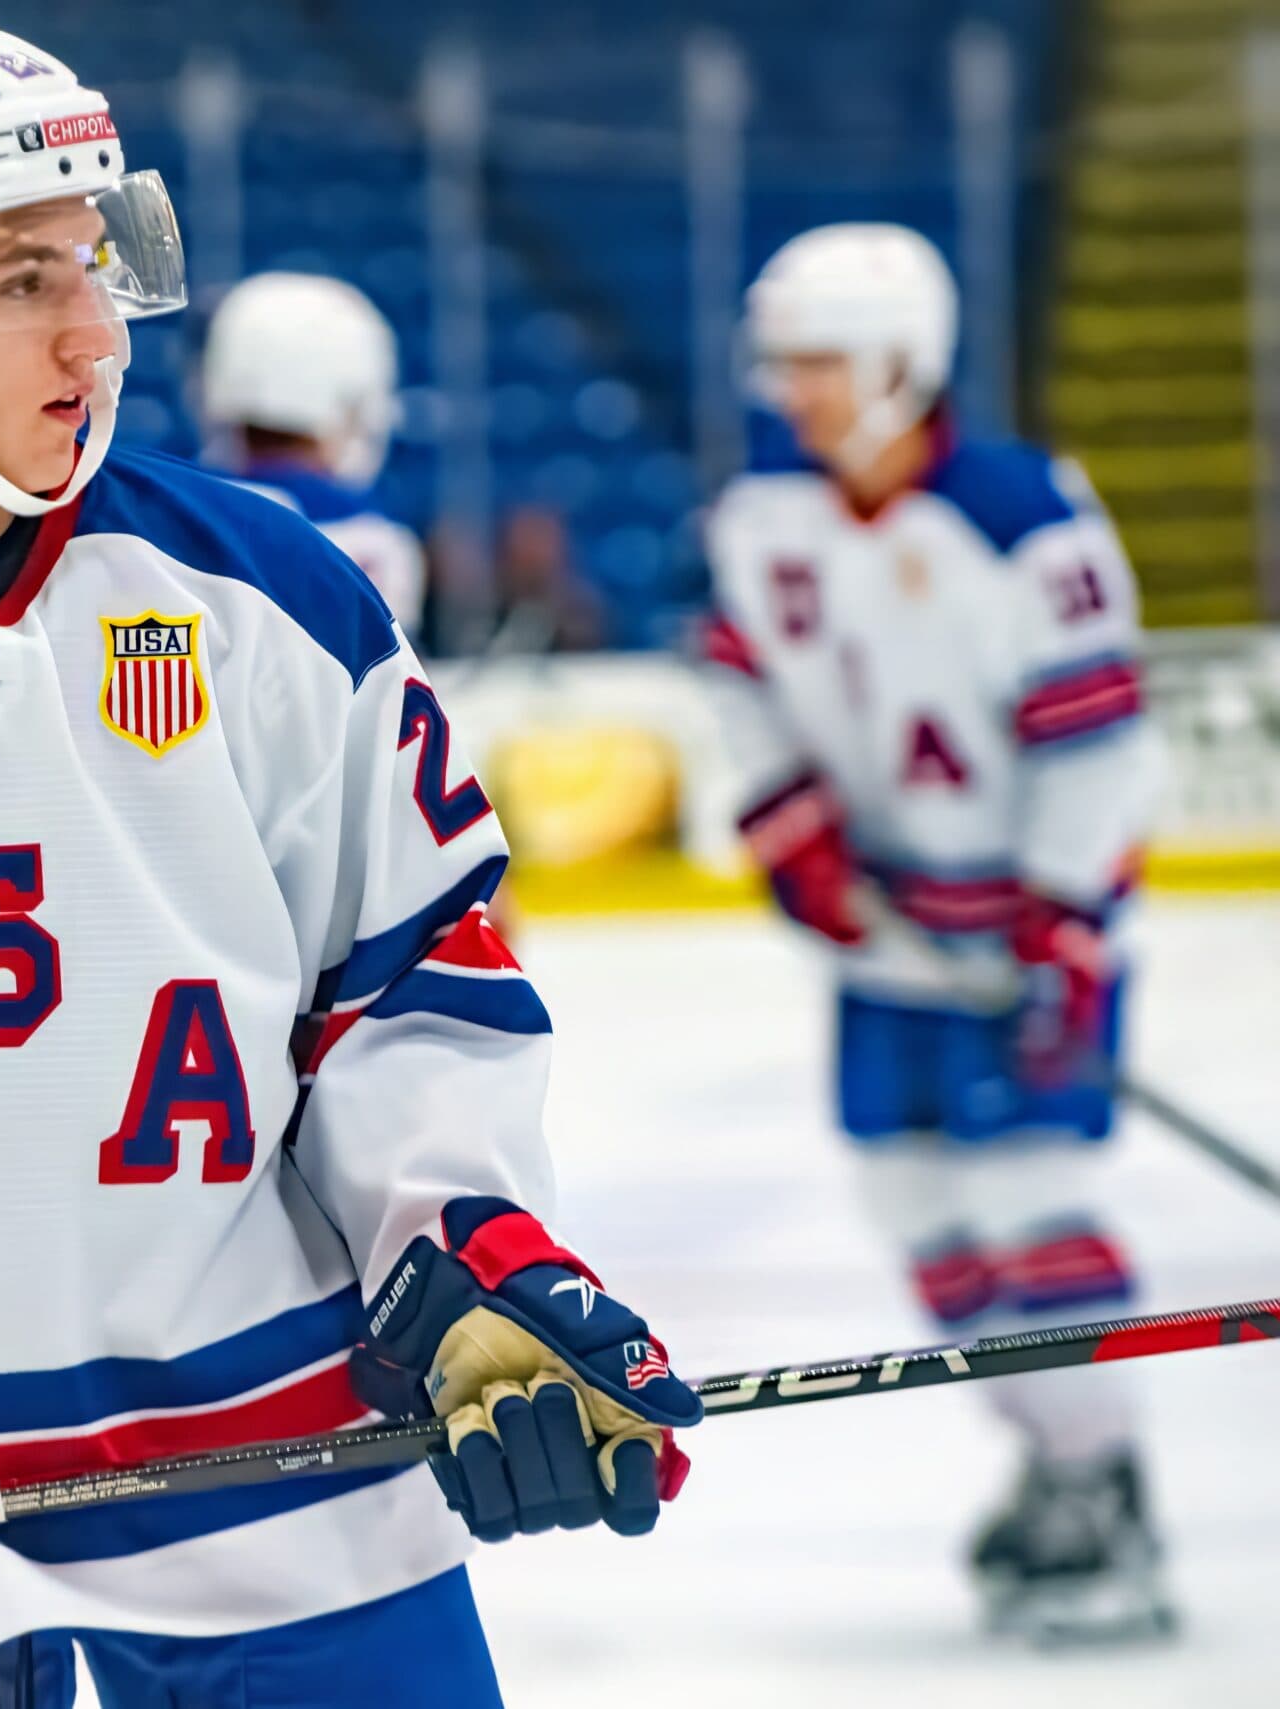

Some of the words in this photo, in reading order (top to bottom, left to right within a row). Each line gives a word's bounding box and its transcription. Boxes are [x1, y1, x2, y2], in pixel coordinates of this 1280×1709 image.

[123, 627, 182, 653] USA
[397, 676, 494, 848] 2
[369, 1260, 417, 1339] BAUER
